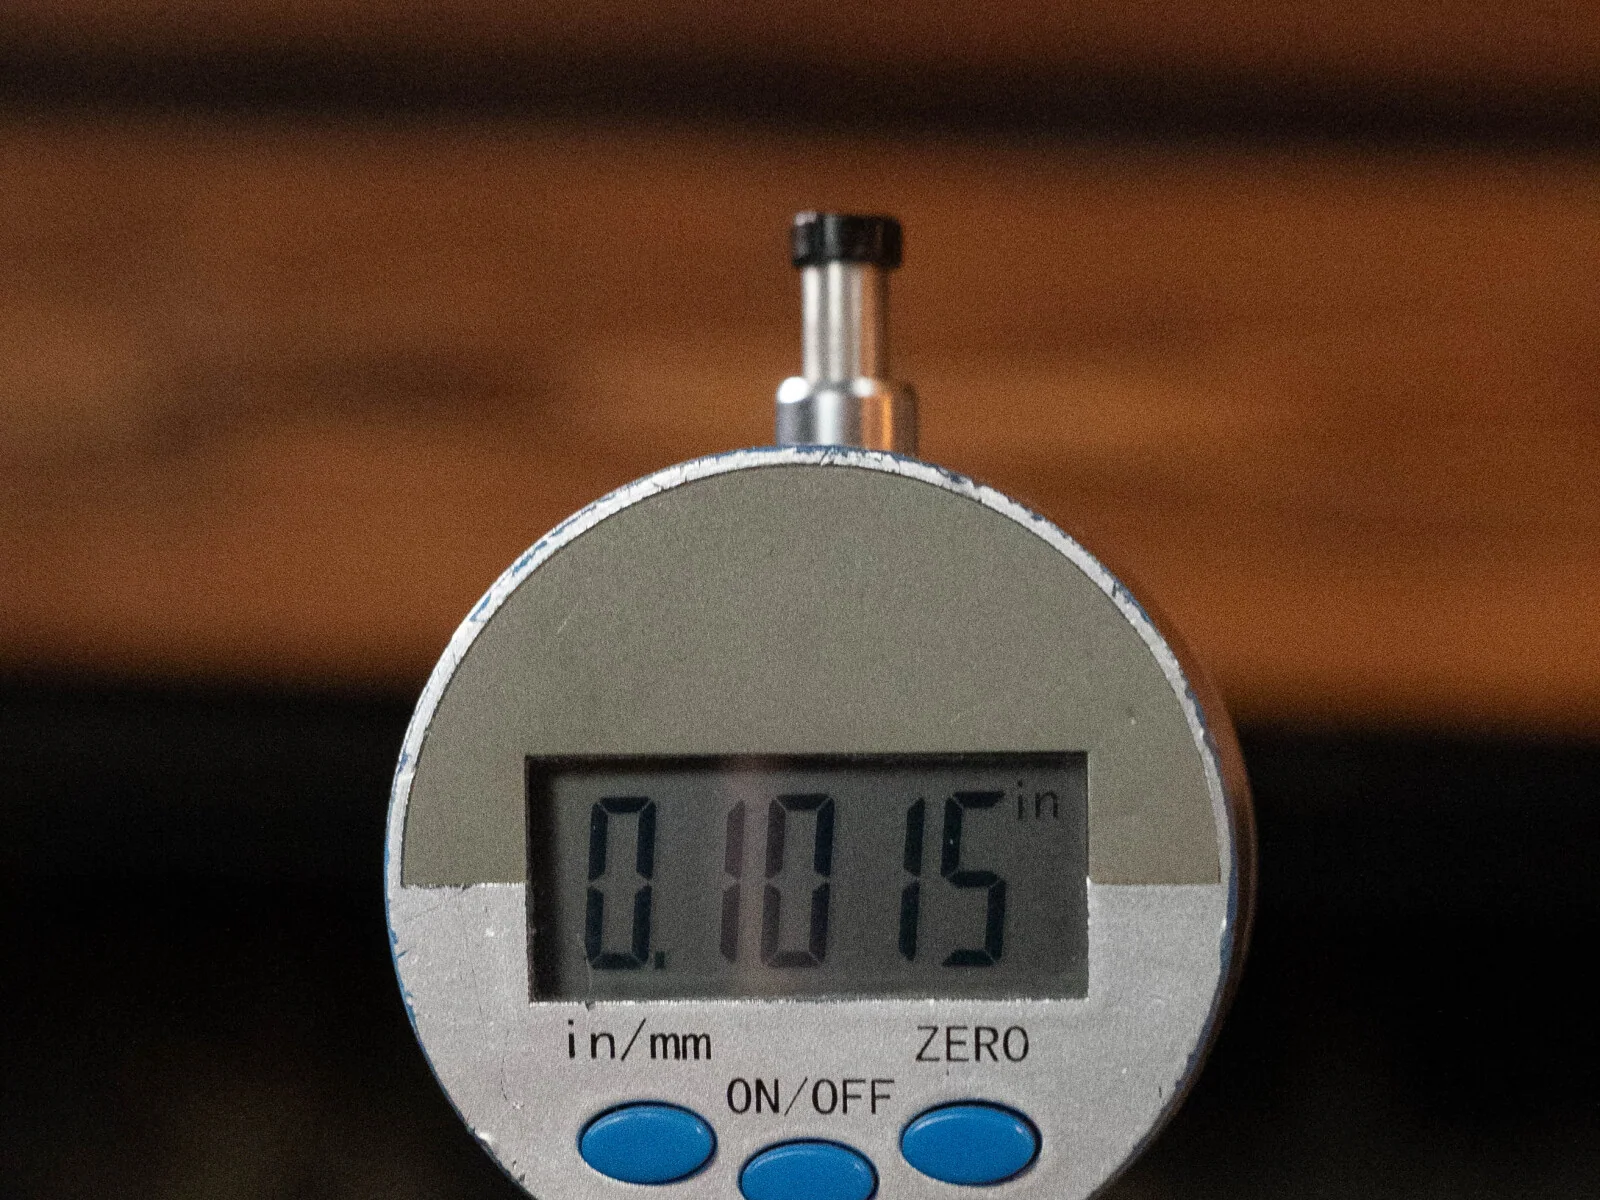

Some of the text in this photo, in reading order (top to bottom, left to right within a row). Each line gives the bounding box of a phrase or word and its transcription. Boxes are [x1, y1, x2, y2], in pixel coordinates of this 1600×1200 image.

[585, 779, 1061, 970] 0.1015 in
[566, 1019, 713, 1061] in/mm
[915, 1025, 1030, 1063] ZERO
[726, 1077, 896, 1115] ON/OFF
